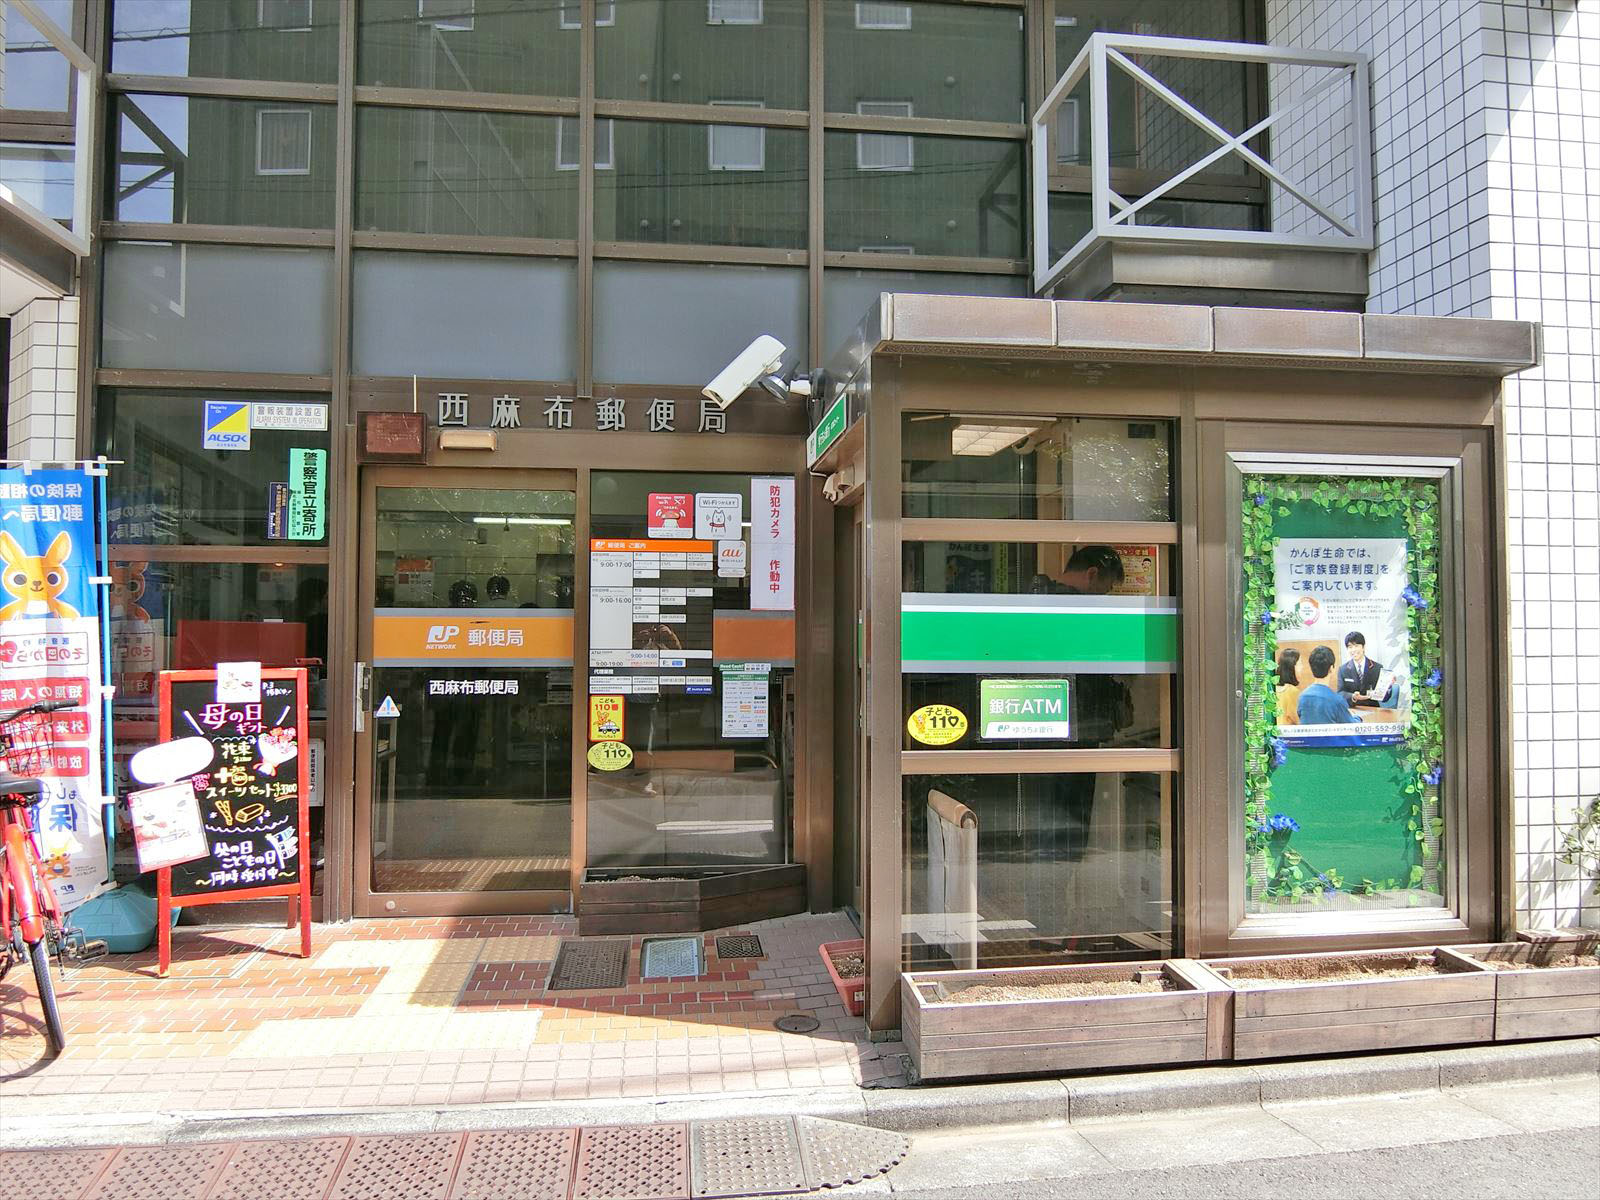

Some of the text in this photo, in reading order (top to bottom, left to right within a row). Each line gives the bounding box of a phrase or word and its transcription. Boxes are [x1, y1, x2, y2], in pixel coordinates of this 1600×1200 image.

[273, 416, 291, 424] SYSTEM
[299, 417, 322, 425] OPERATION
[438, 393, 727, 433] 西麻布郵便局
[207, 434, 247, 443] ALSOK
[302, 452, 317, 537] 警察官立寄所
[769, 485, 781, 538] 防犯カメラ
[721, 548, 744, 558] au
[1290, 547, 1372, 559] かんぽ生命では、
[769, 559, 781, 594] 作動中
[1289, 564, 1389, 575] 「ご家族登録制度」を
[1291, 581, 1378, 591] ご案内しています。
[468, 629, 524, 646] 郵便局
[429, 680, 519, 695] 西麻布郵便局
[925, 707, 953, 716] 子ども
[989, 698, 1062, 714] 銀行ATM
[199, 704, 262, 729] 母の日
[236, 722, 268, 735] ギフト
[1013, 726, 1053, 734] ゆうちょ銀行
[221, 741, 253, 759] 花束
[222, 850, 276, 868] こどもの日
